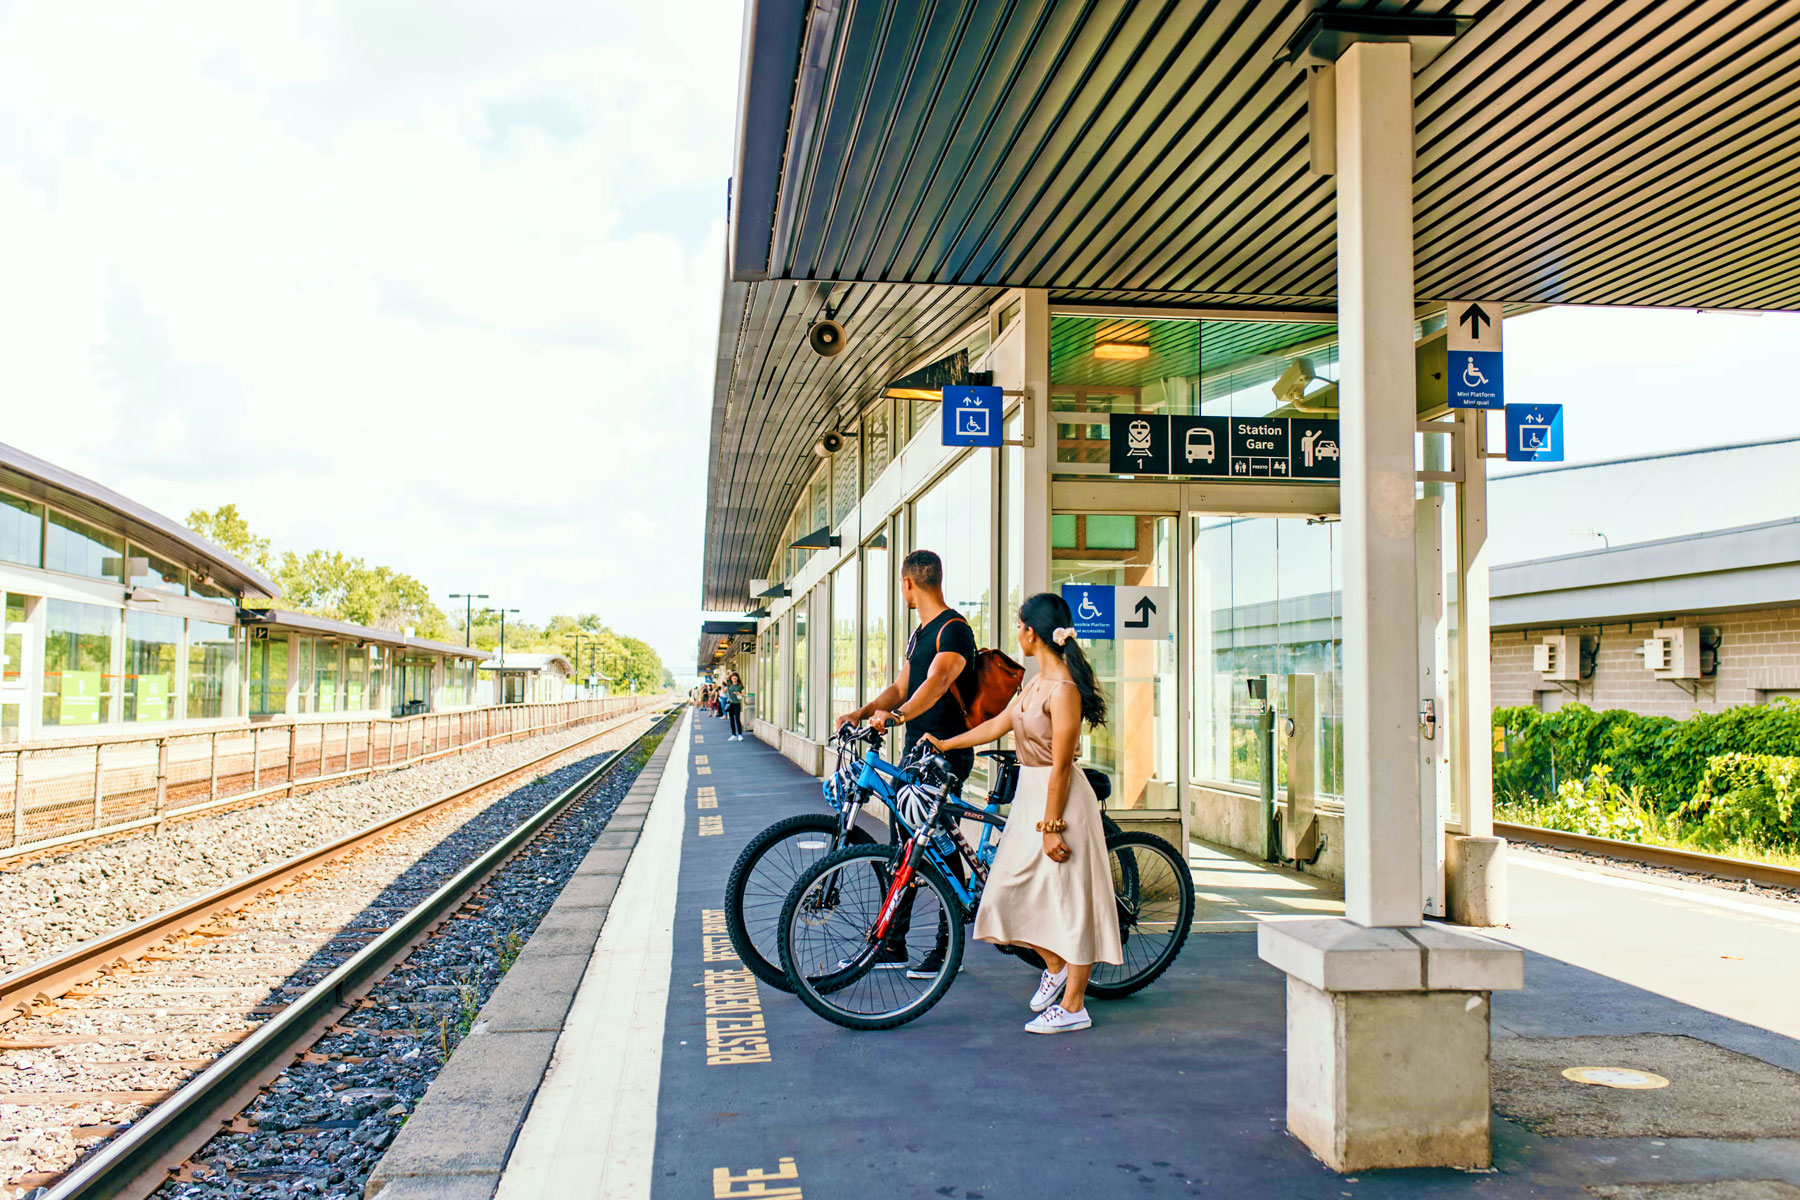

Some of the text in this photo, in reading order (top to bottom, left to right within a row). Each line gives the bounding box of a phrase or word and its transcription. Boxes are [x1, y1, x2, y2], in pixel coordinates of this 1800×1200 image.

[1238, 424, 1282, 436] Station
[1246, 439, 1275, 450] Gare
[1136, 458, 1144, 469] 1
[706, 1013, 772, 1066] RESTEZ
[713, 1157, 803, 1200] FE.
